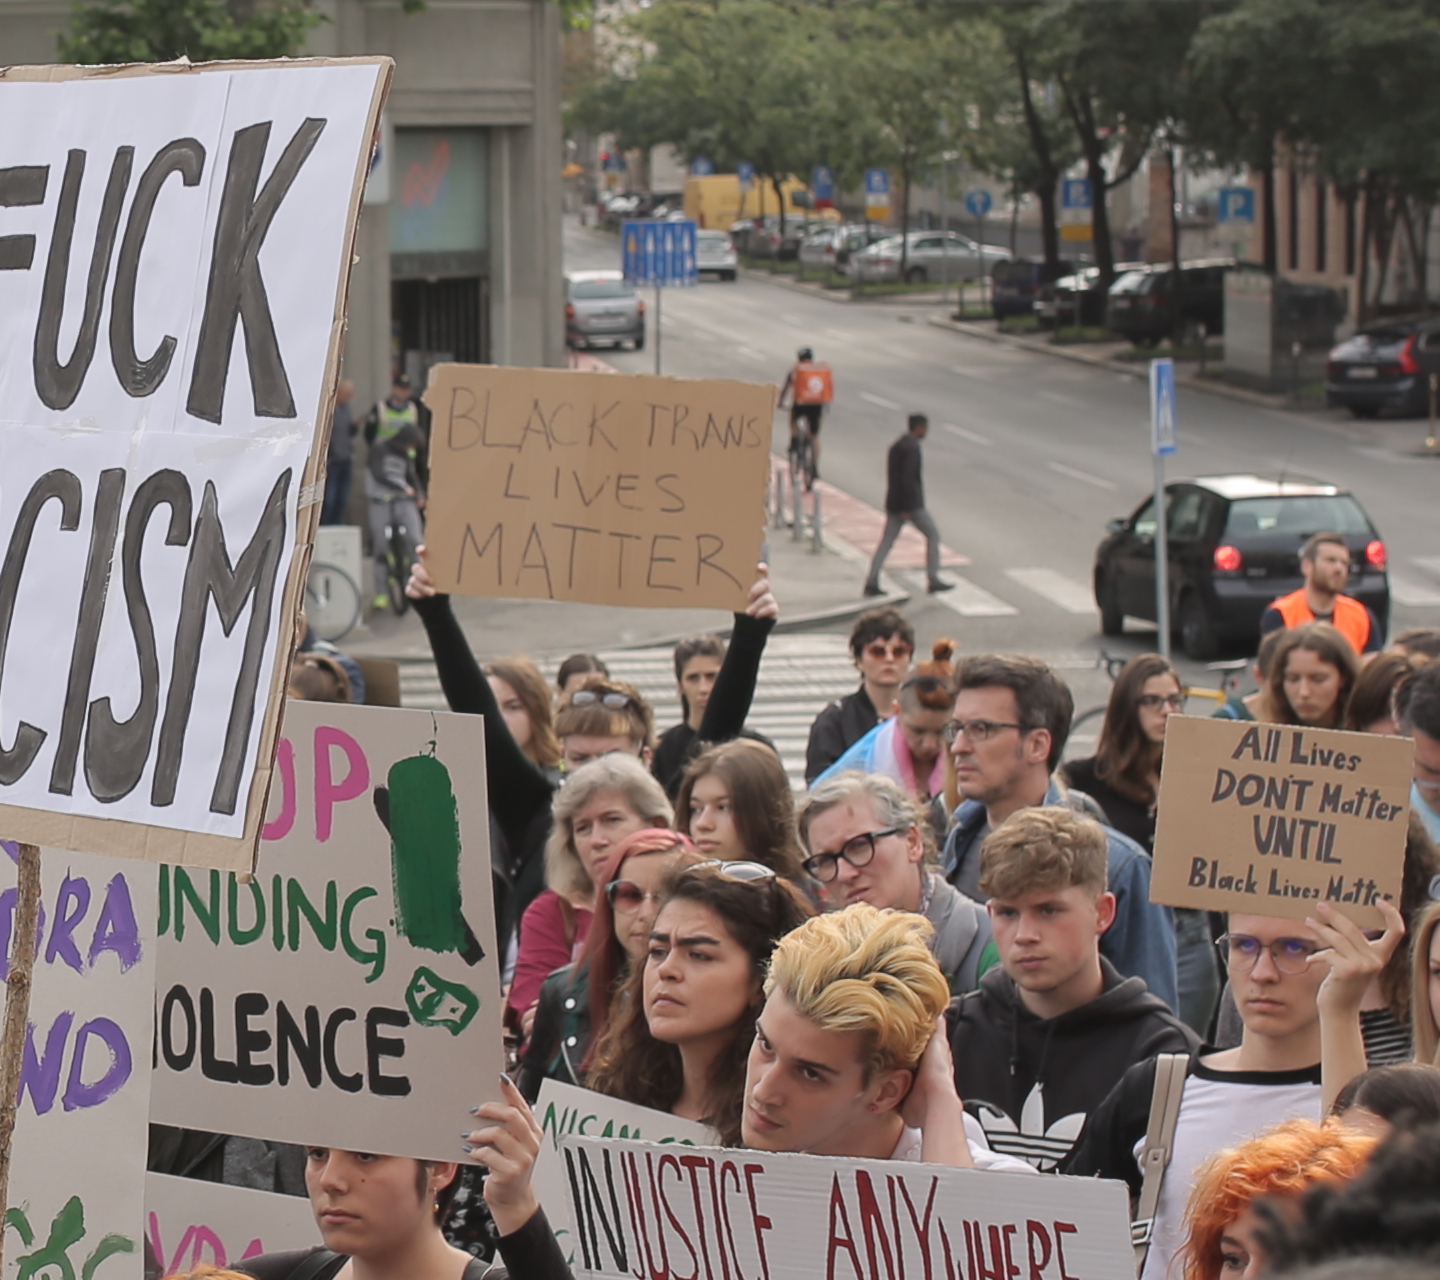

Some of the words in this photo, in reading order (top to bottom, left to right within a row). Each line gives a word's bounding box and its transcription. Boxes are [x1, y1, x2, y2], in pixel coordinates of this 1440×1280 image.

[446, 386, 629, 451] BLACK
[643, 402, 763, 452] TRANS
[503, 464, 687, 514] LIVES
[456, 521, 744, 601] MATTER
[1231, 727, 1282, 764] All
[1289, 731, 1362, 771] Lives
[1211, 767, 1314, 812] DON'T
[1318, 781, 1403, 822] Matter
[1252, 814, 1342, 864] UNTIL
[1188, 857, 1258, 894] Black
[1267, 868, 1321, 899] Lives
[1325, 875, 1394, 907] Matter
[152, 985, 411, 1097] OLENCE
